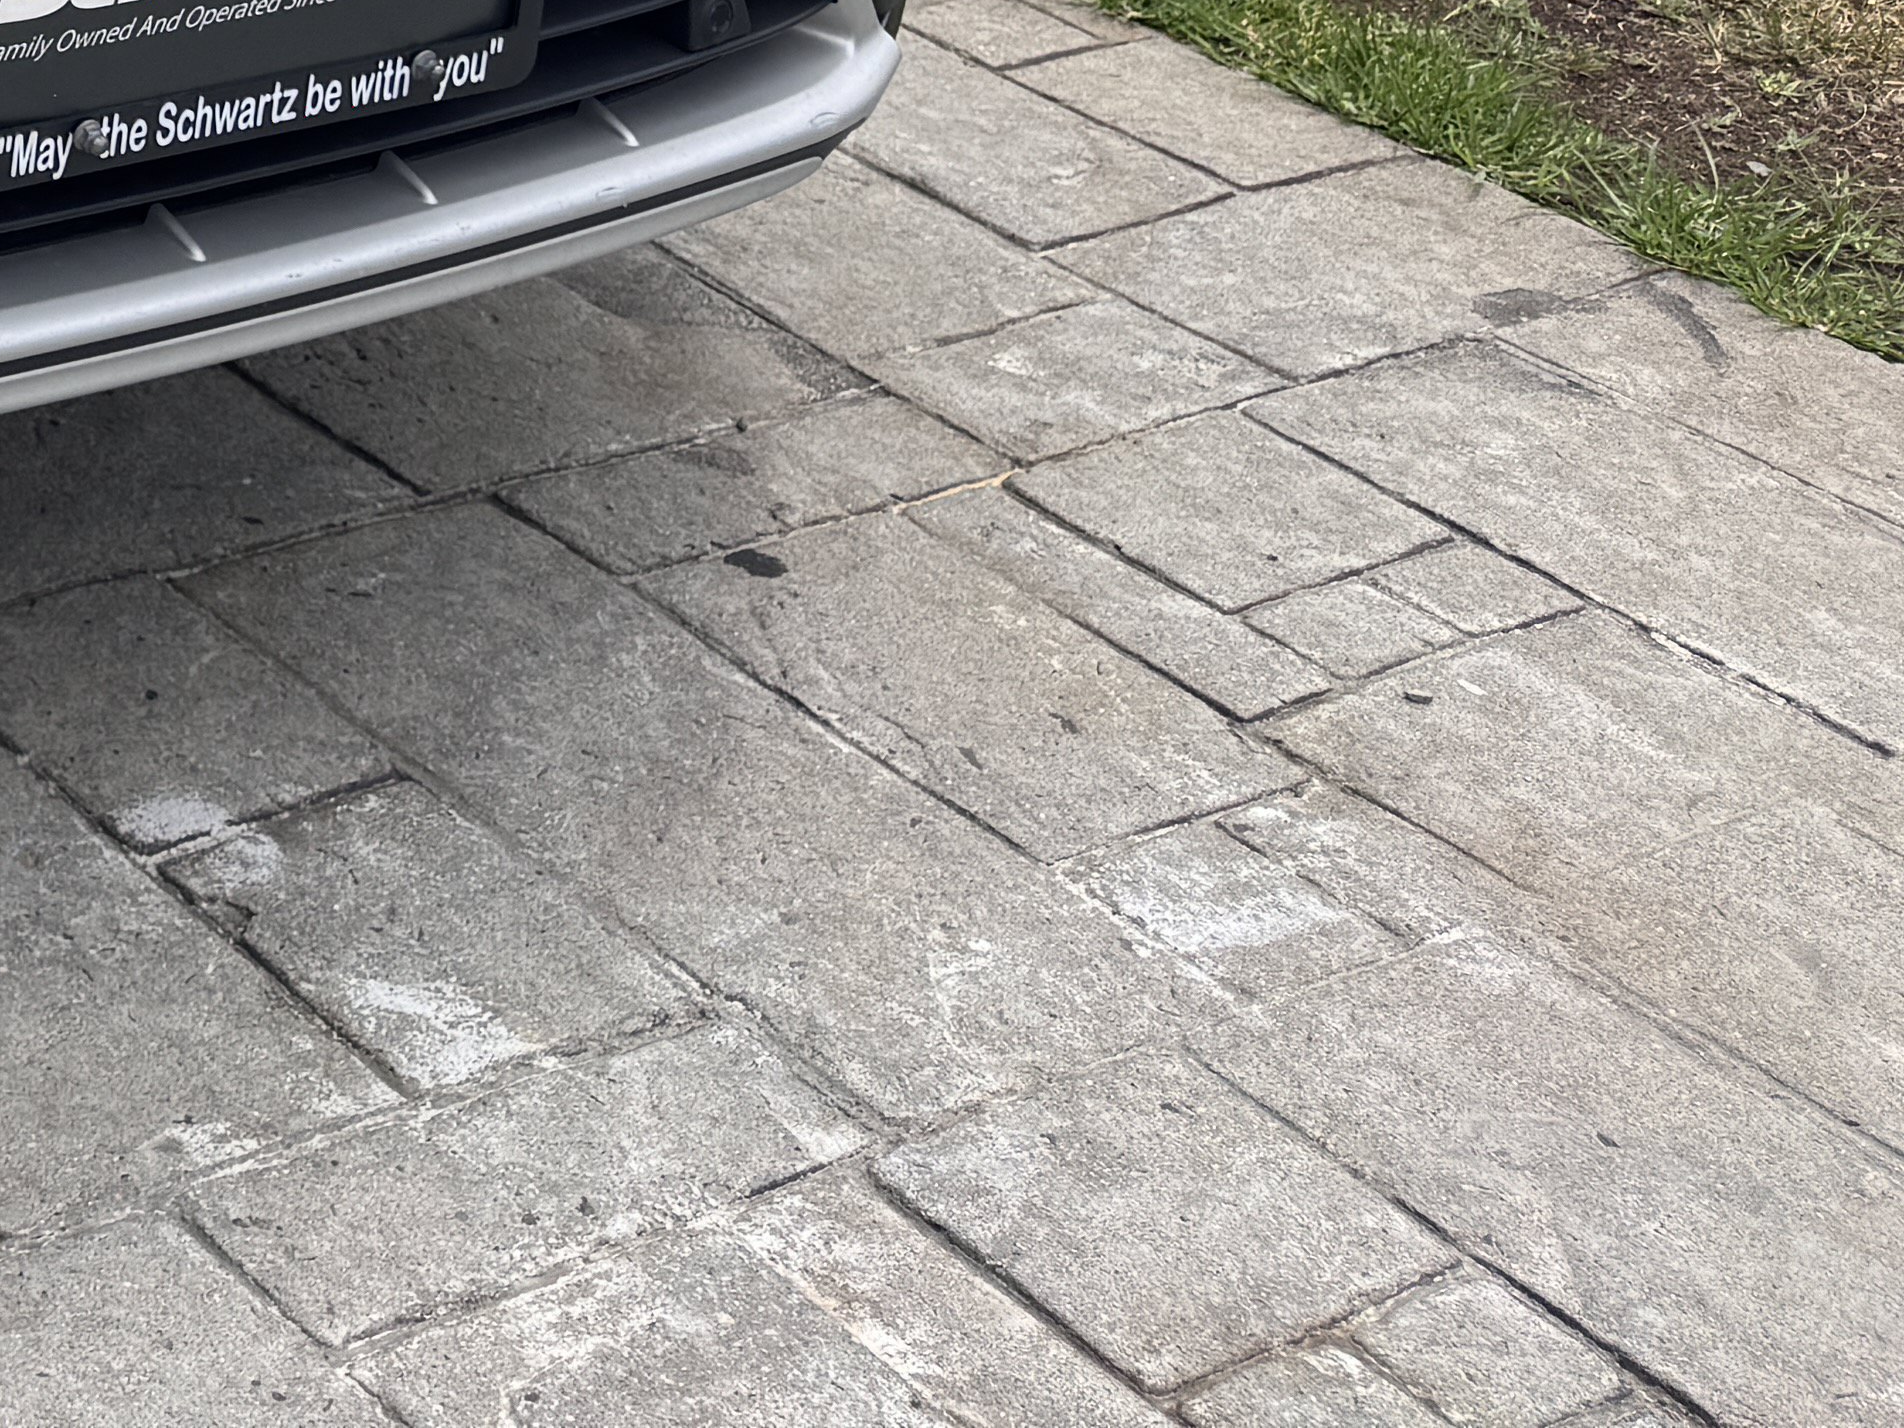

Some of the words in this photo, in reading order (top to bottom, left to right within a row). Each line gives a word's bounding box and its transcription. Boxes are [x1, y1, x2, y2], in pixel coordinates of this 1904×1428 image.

[56, 17, 137, 53] Owned
[136, 8, 185, 38] And
[155, 80, 299, 147] Schwartz
[304, 73, 342, 118] be
[350, 55, 411, 108] with
[433, 36, 504, 102] you"
